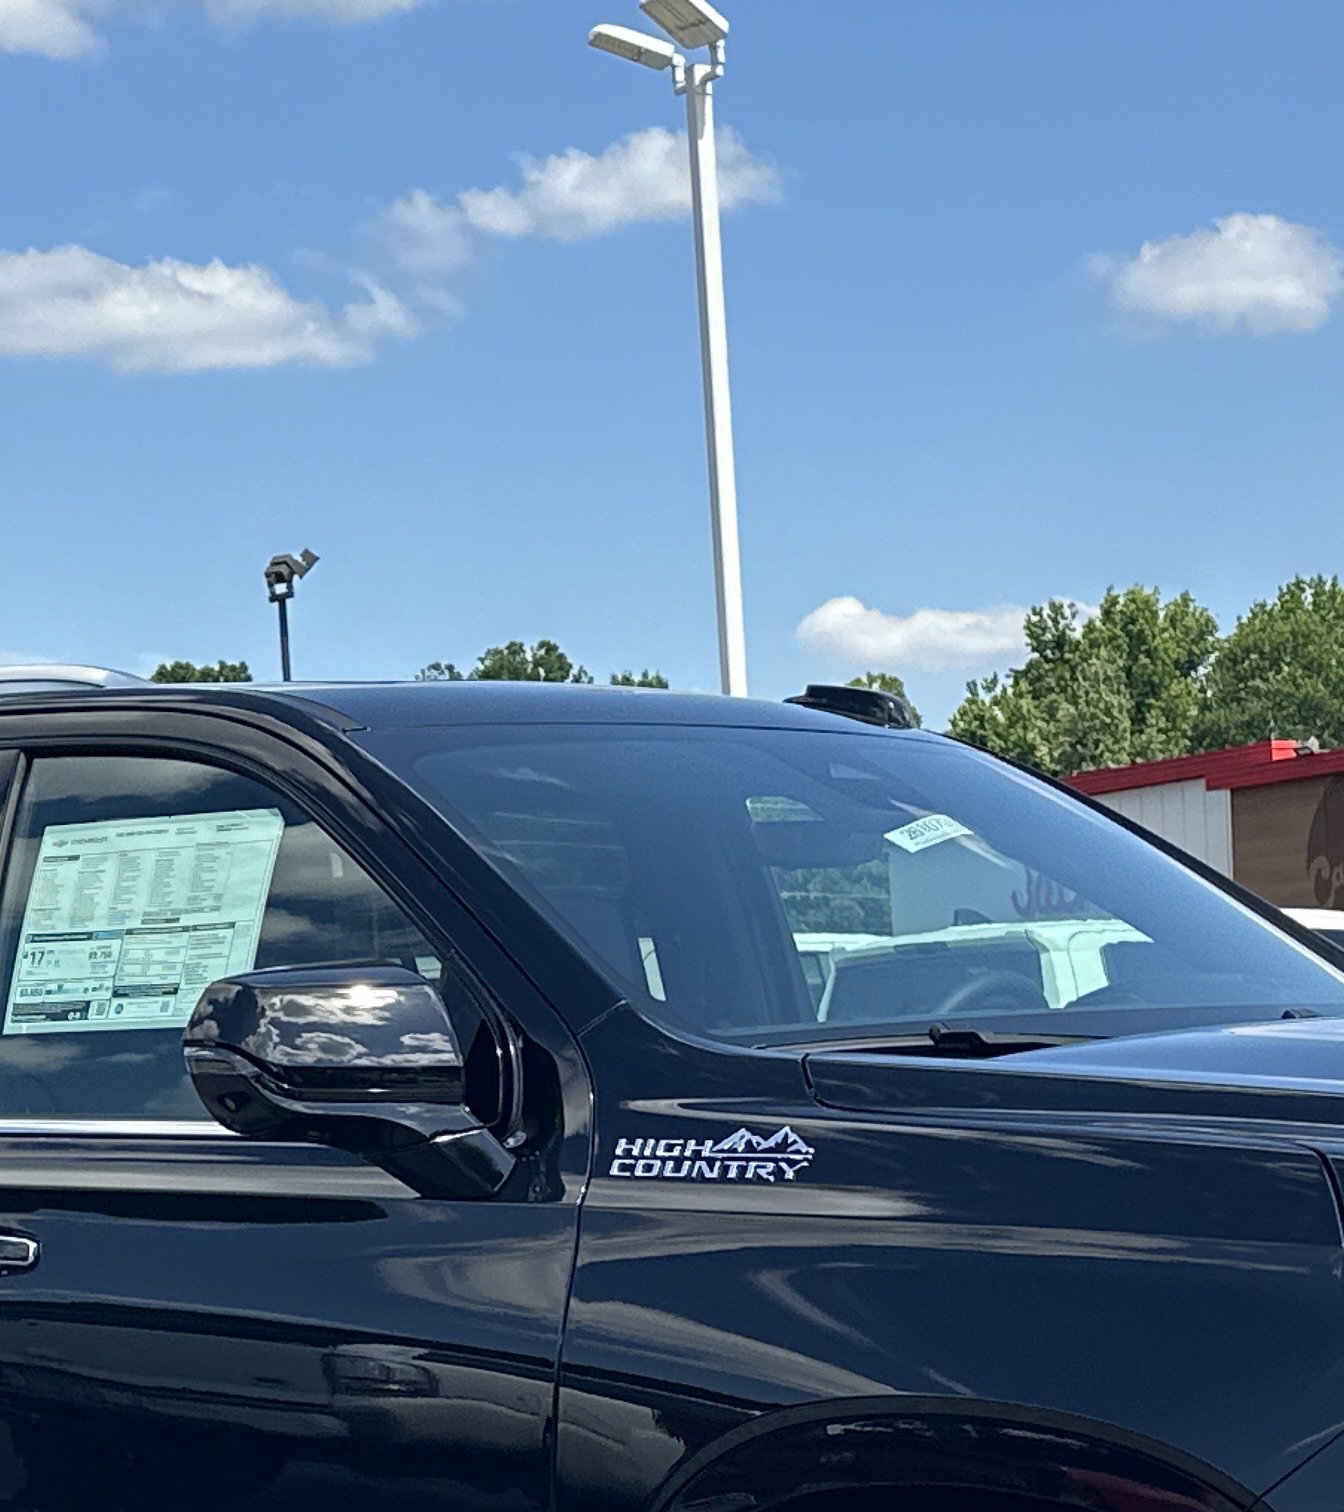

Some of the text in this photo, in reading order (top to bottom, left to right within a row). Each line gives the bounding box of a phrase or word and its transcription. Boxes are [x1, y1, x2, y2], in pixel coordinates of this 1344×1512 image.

[30, 950, 45, 966] 17
[614, 1137, 716, 1158] HIGH
[608, 1158, 810, 1183] COUNTRY
